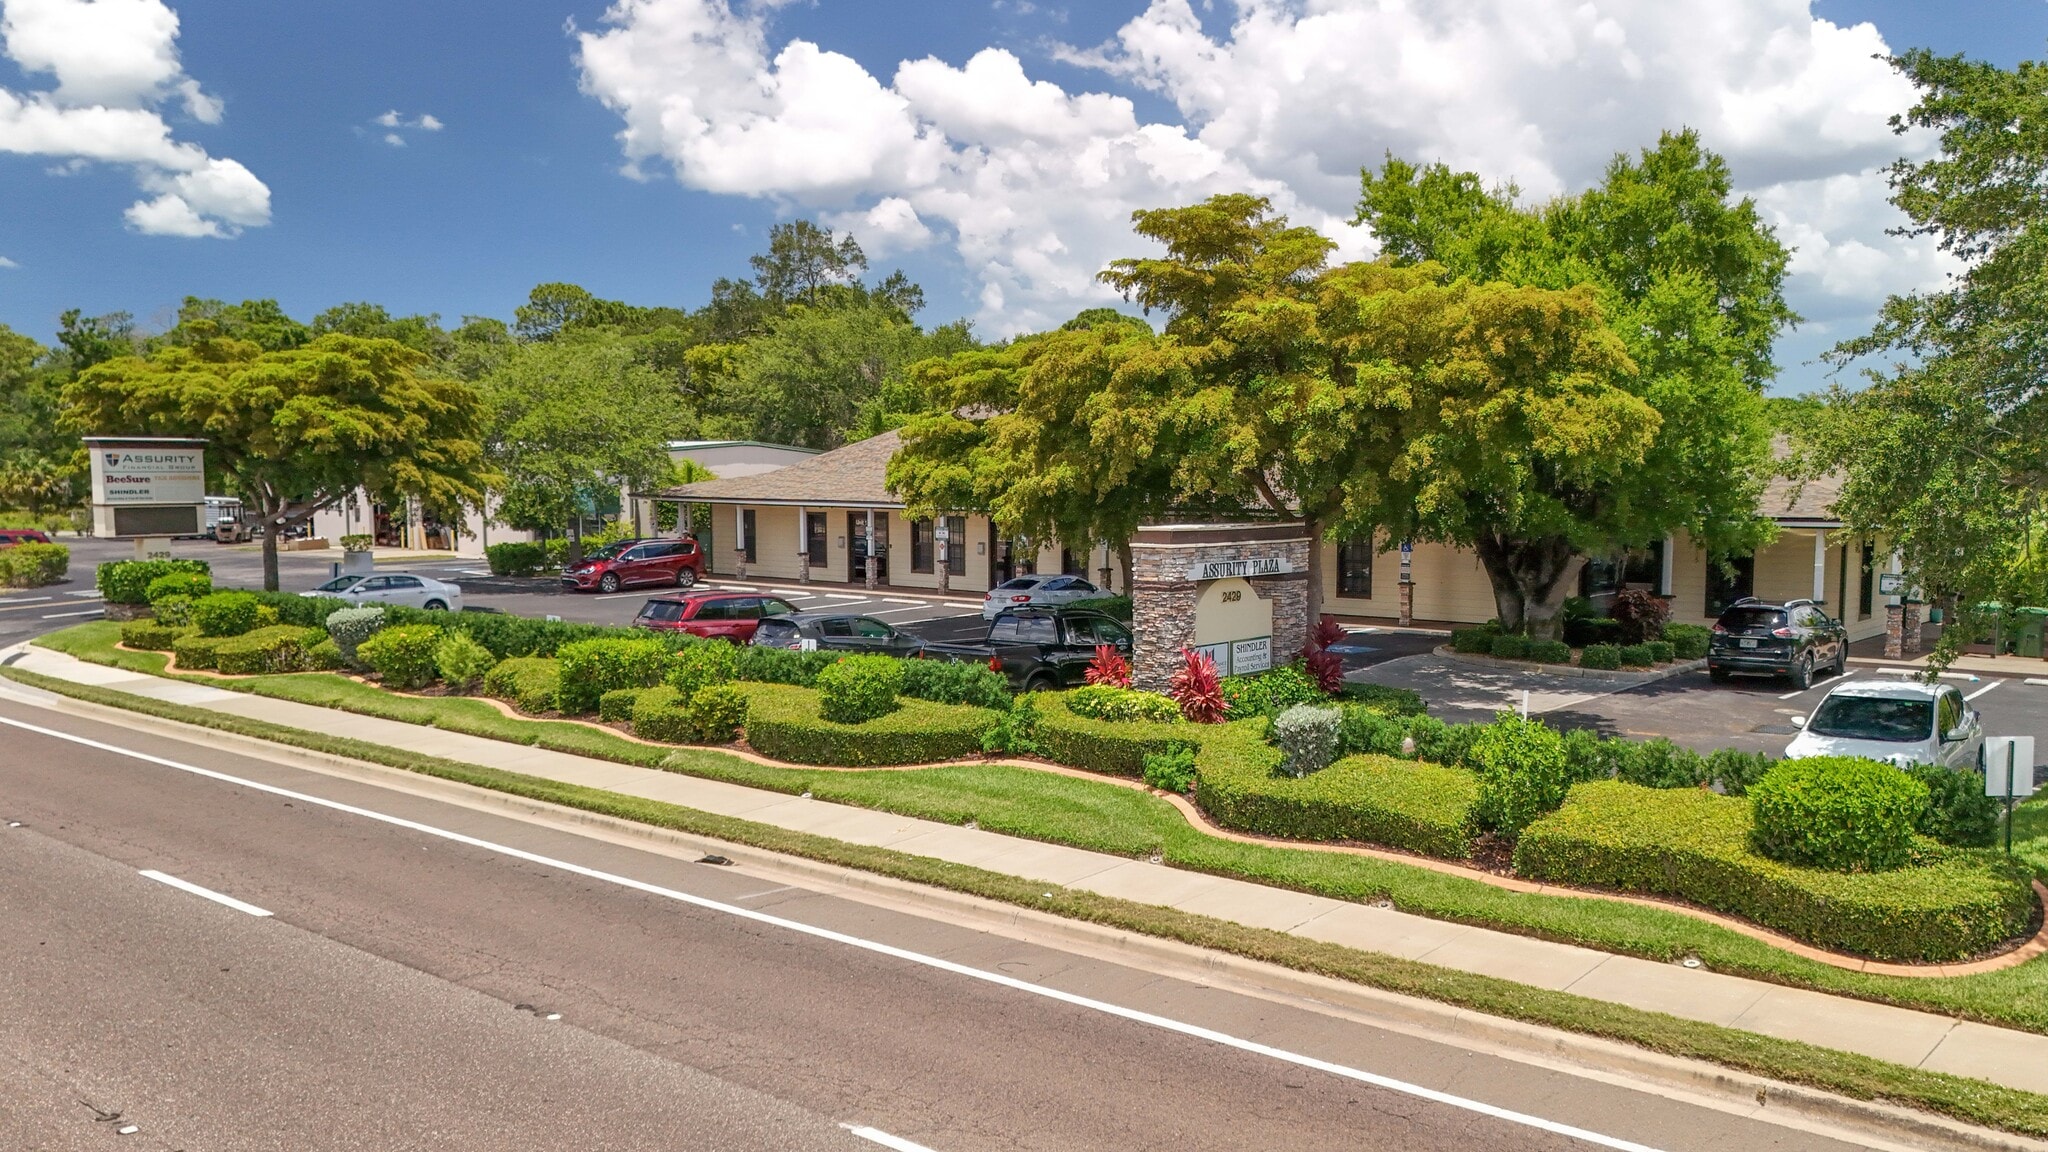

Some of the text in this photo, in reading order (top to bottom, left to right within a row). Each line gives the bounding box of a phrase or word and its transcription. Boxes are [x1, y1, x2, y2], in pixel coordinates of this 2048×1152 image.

[122, 454, 195, 463] ASSURITY
[106, 475, 151, 483] BeeSure
[147, 551, 171, 559] 2429
[1202, 559, 1280, 578] ASSURITY PLAZA
[1222, 590, 1242, 602] 2429
[1236, 641, 1268, 654] SHINDLER
